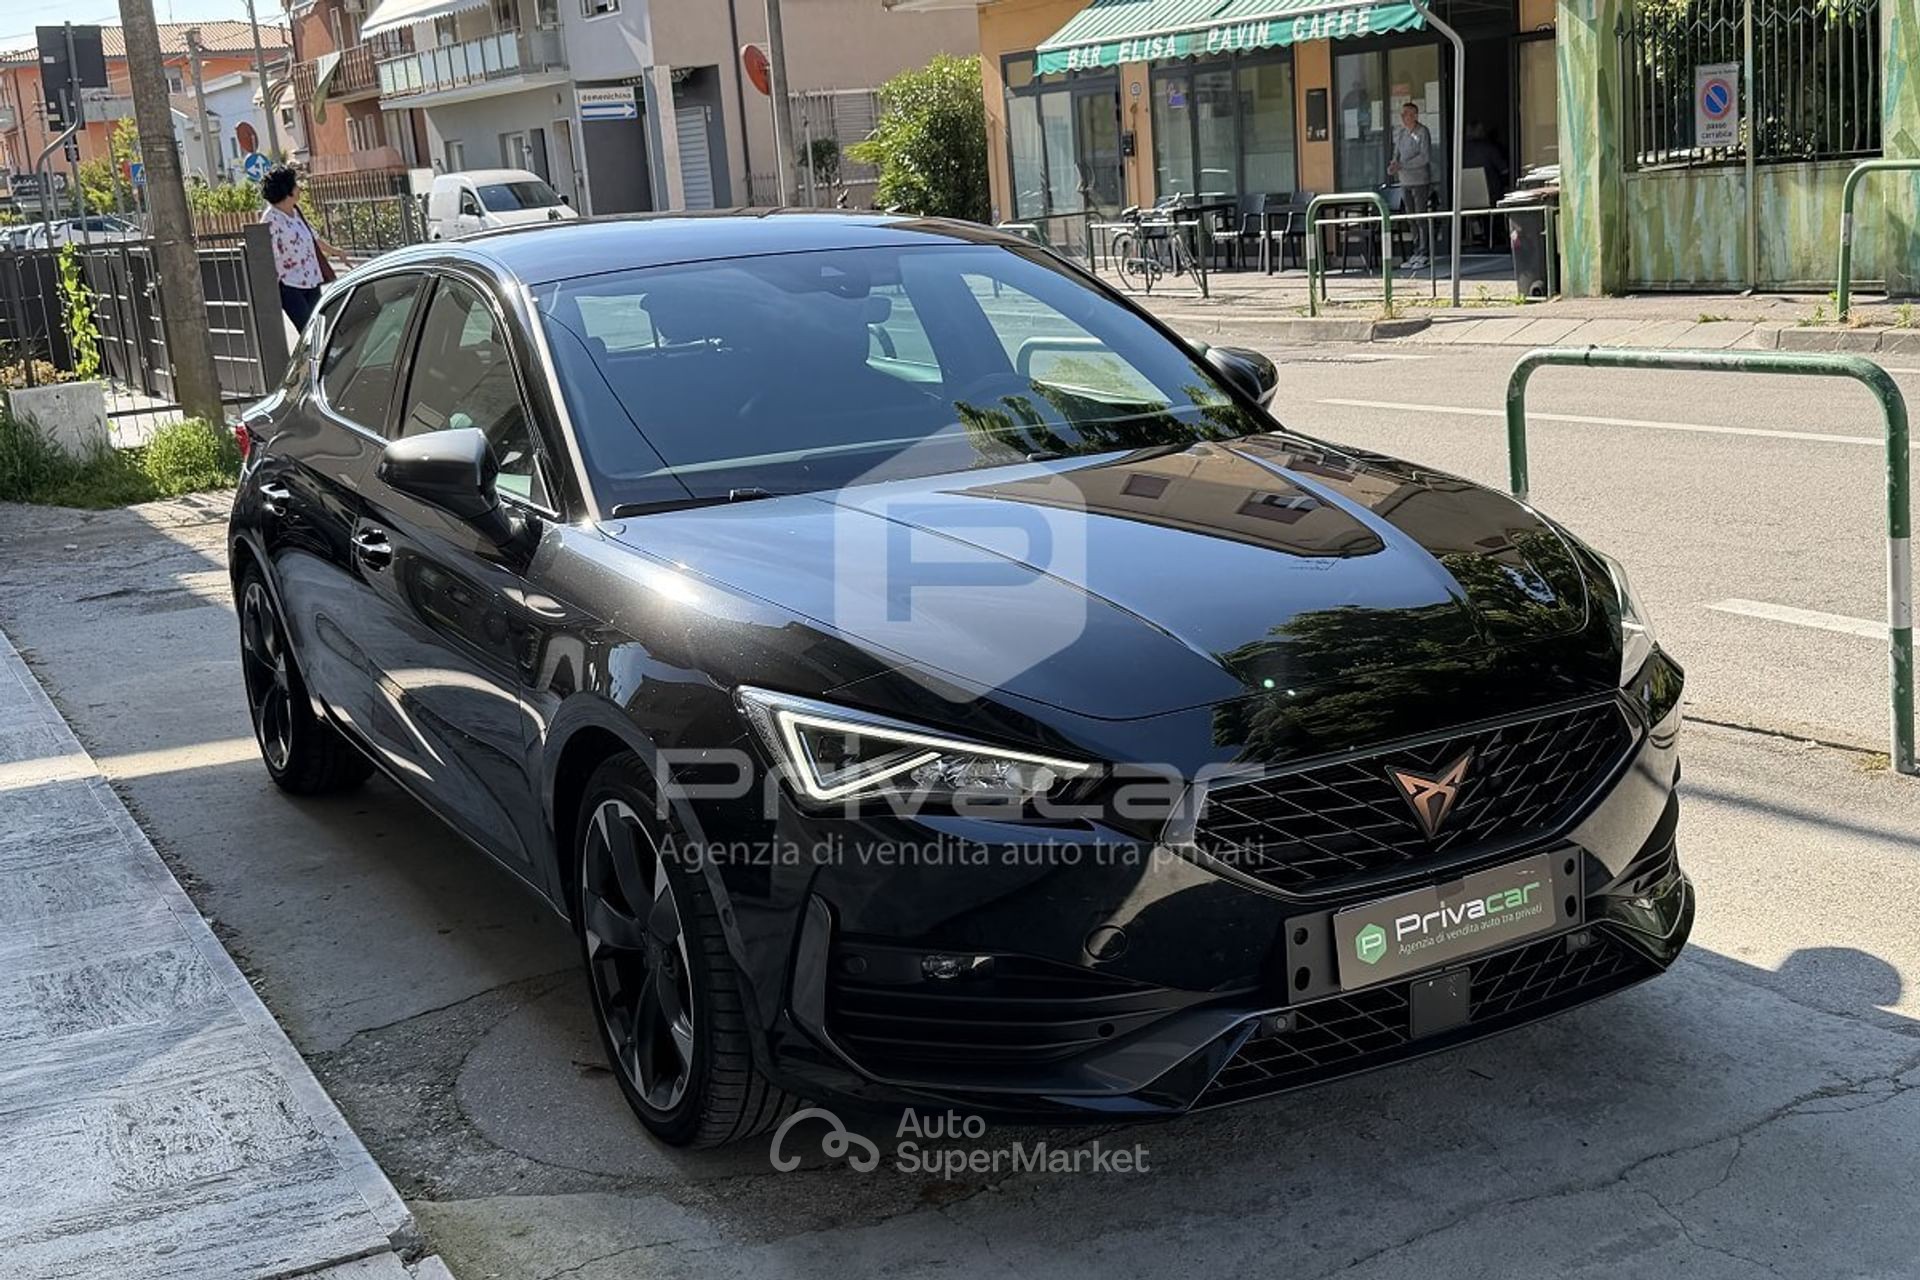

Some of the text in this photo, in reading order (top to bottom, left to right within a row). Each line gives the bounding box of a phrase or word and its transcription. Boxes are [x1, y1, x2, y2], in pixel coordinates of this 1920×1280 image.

[1067, 46, 1101, 69] BAR
[1118, 35, 1176, 63] ELISA
[1206, 21, 1269, 52] PAVIN
[1395, 881, 1540, 942] Privacar
[1399, 902, 1543, 955] Agenzia di vendita auto tra privati
